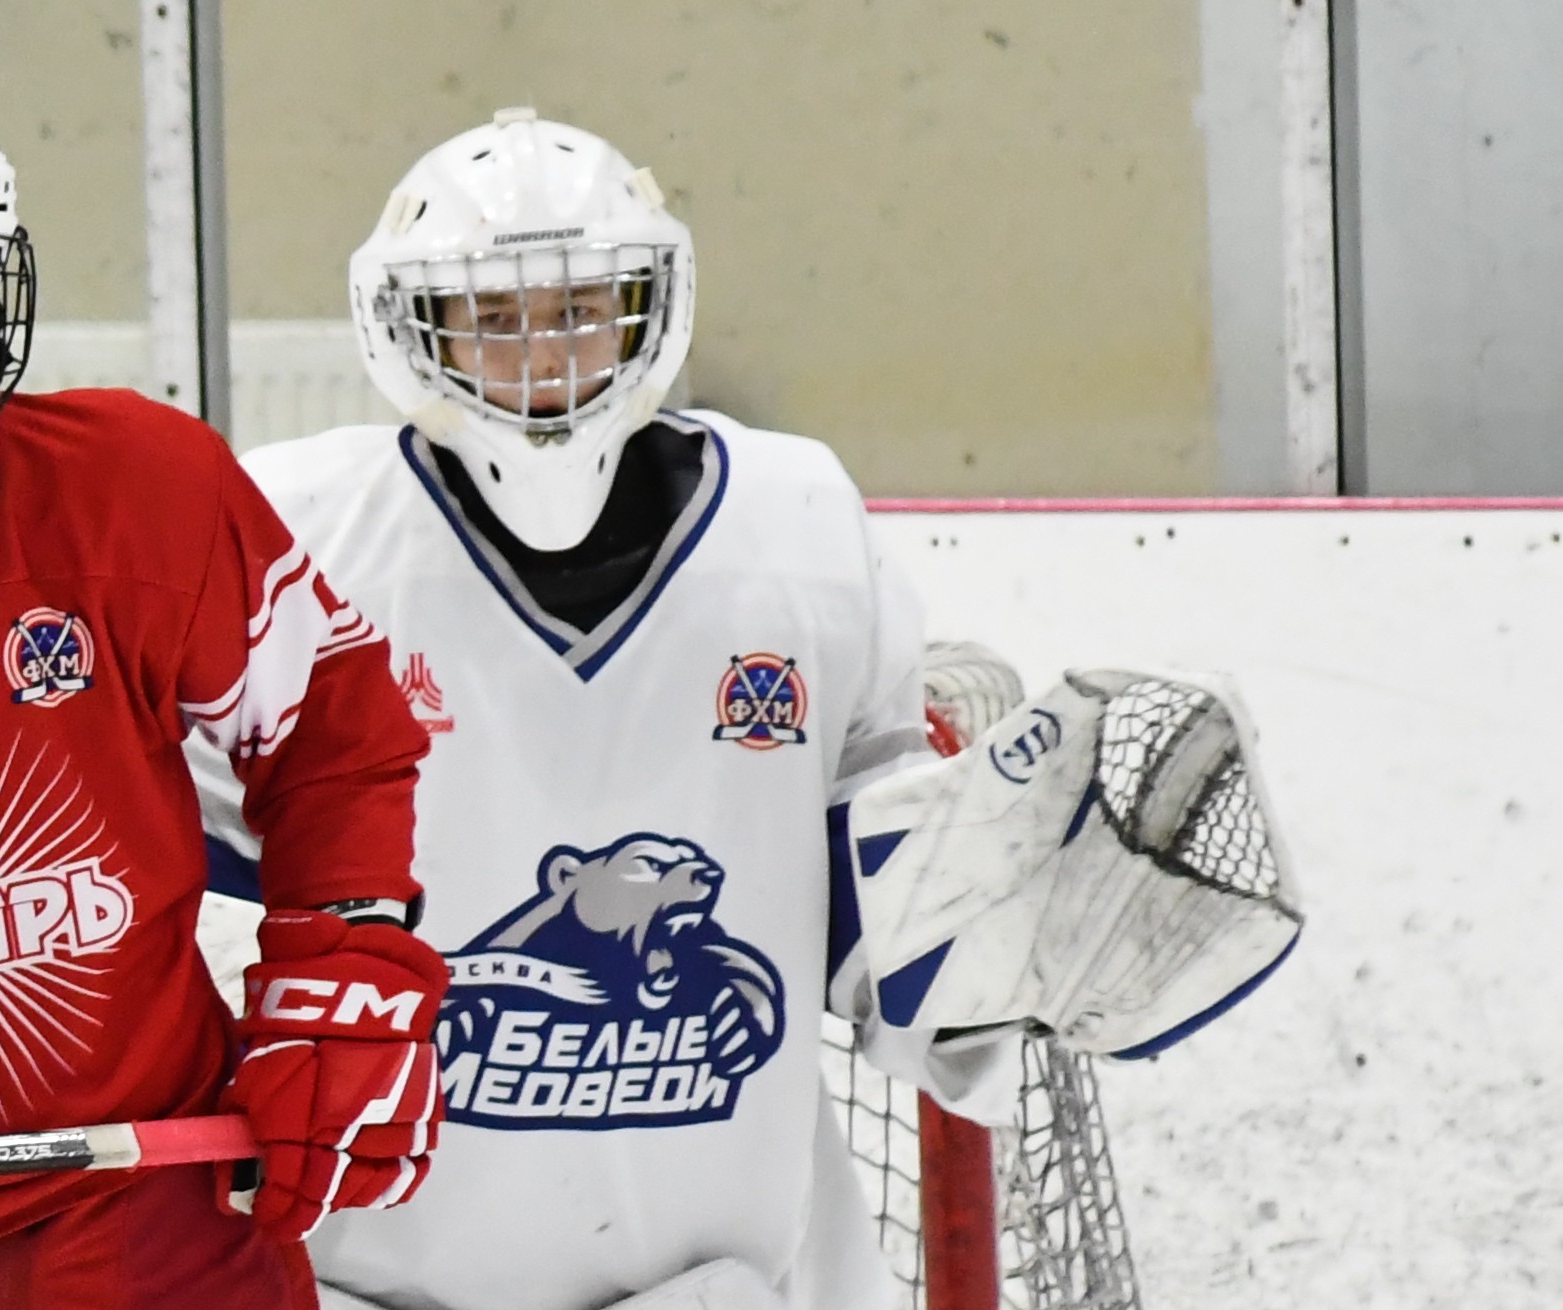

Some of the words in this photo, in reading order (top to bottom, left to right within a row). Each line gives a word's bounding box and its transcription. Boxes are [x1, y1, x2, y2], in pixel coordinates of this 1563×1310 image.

[22, 652, 81, 682] ФХМ
[727, 698, 794, 724] ФХМ
[447, 960, 553, 984] ОСКВА
[259, 977, 426, 1032] CM
[488, 1010, 709, 1068] БЕЛЫЕ
